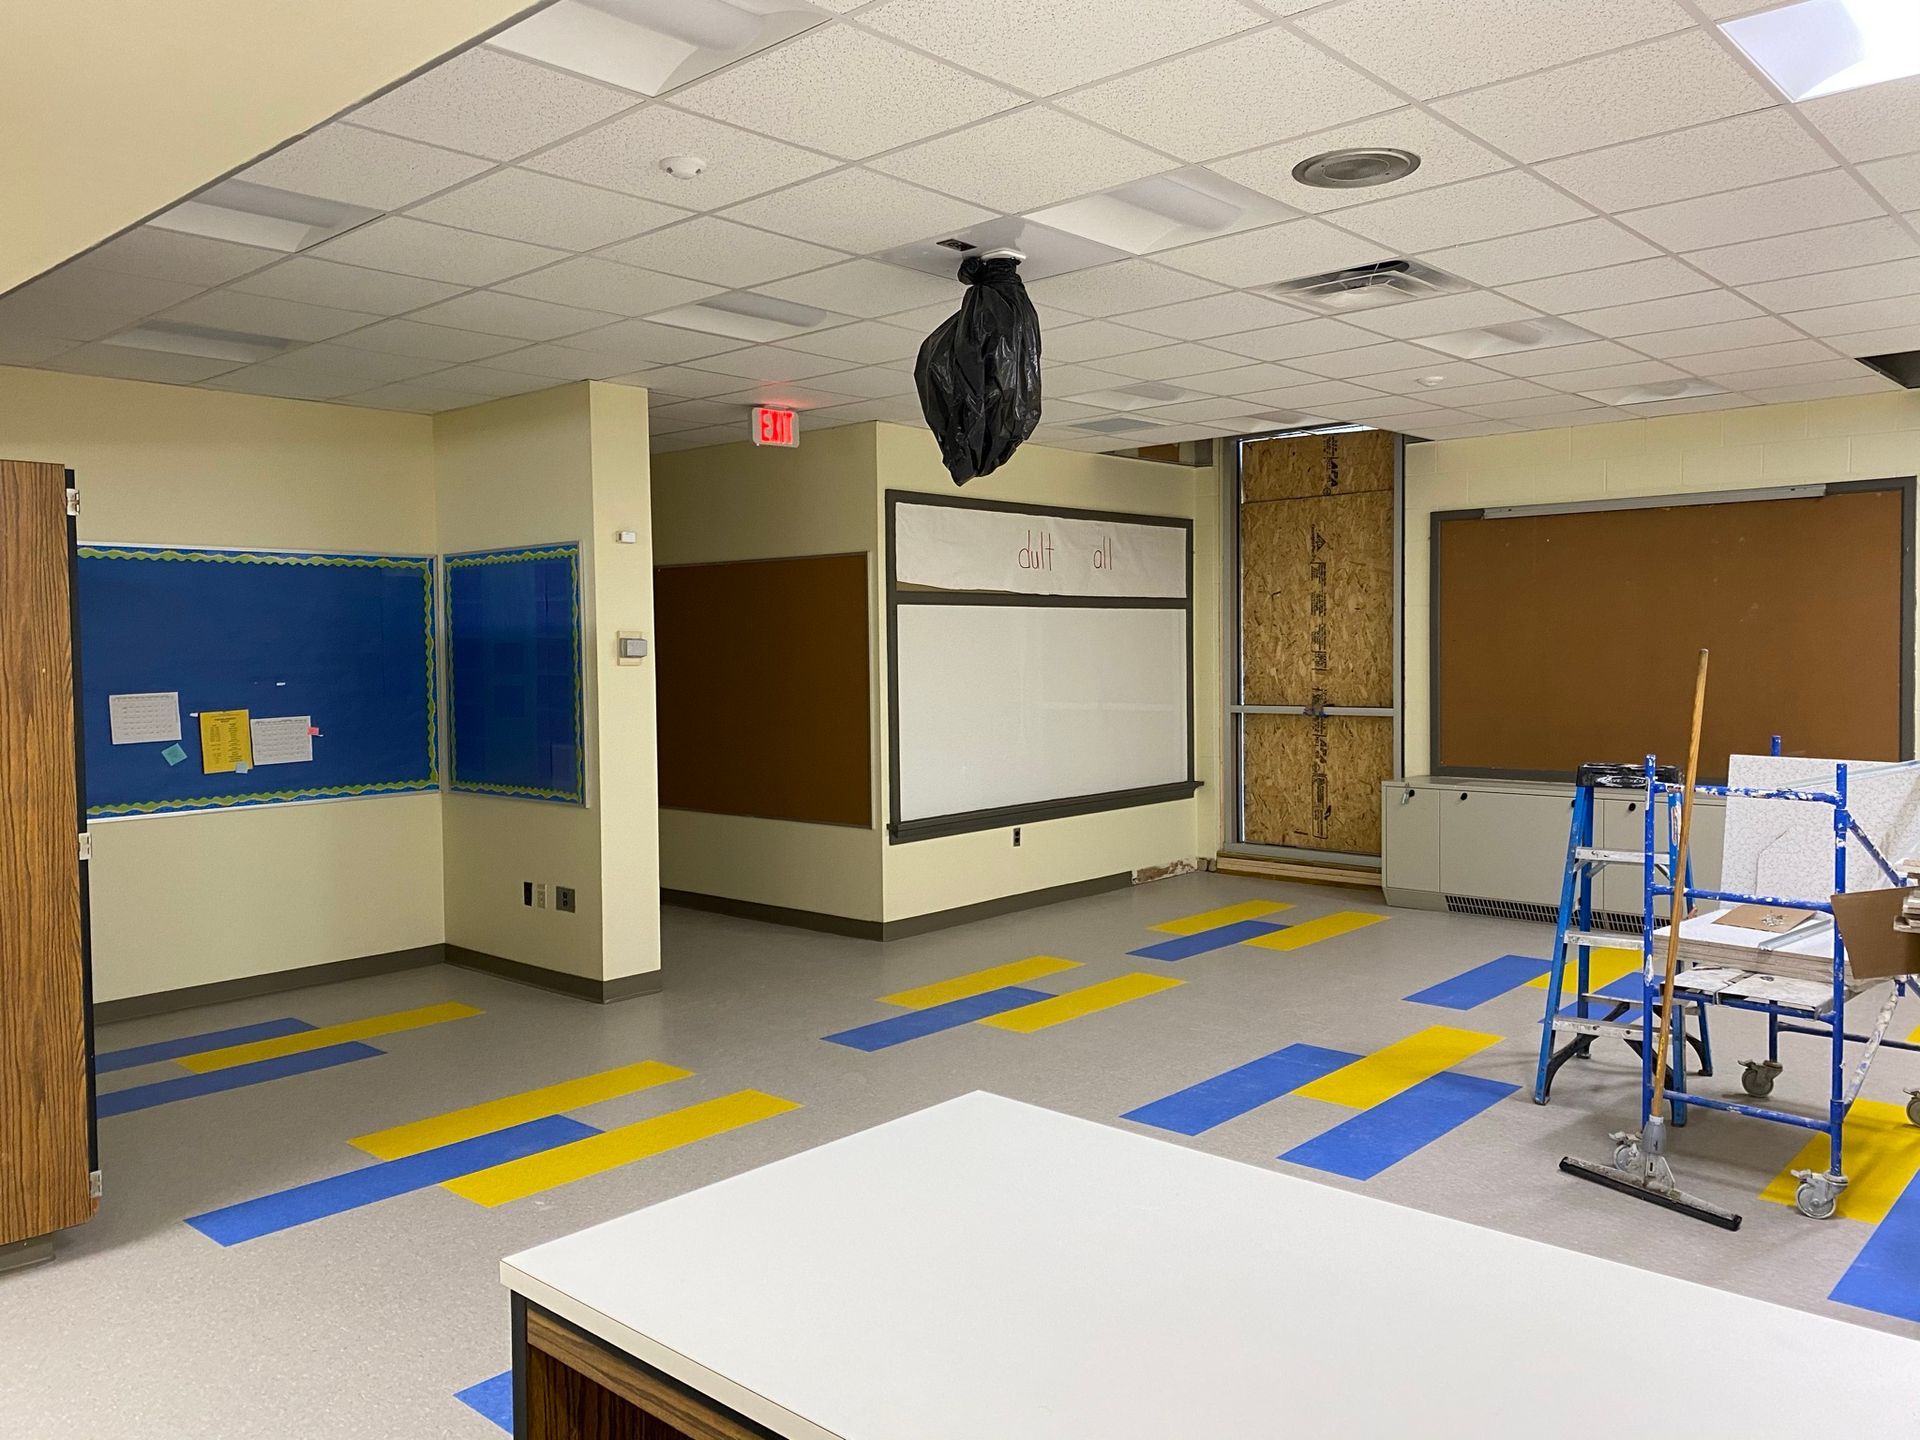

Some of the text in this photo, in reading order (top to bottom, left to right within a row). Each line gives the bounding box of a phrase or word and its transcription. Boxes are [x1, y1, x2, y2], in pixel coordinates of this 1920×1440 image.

[760, 408, 793, 444] EXIT
[1331, 460, 1339, 487] APA
[1019, 530, 1112, 571] dult all
